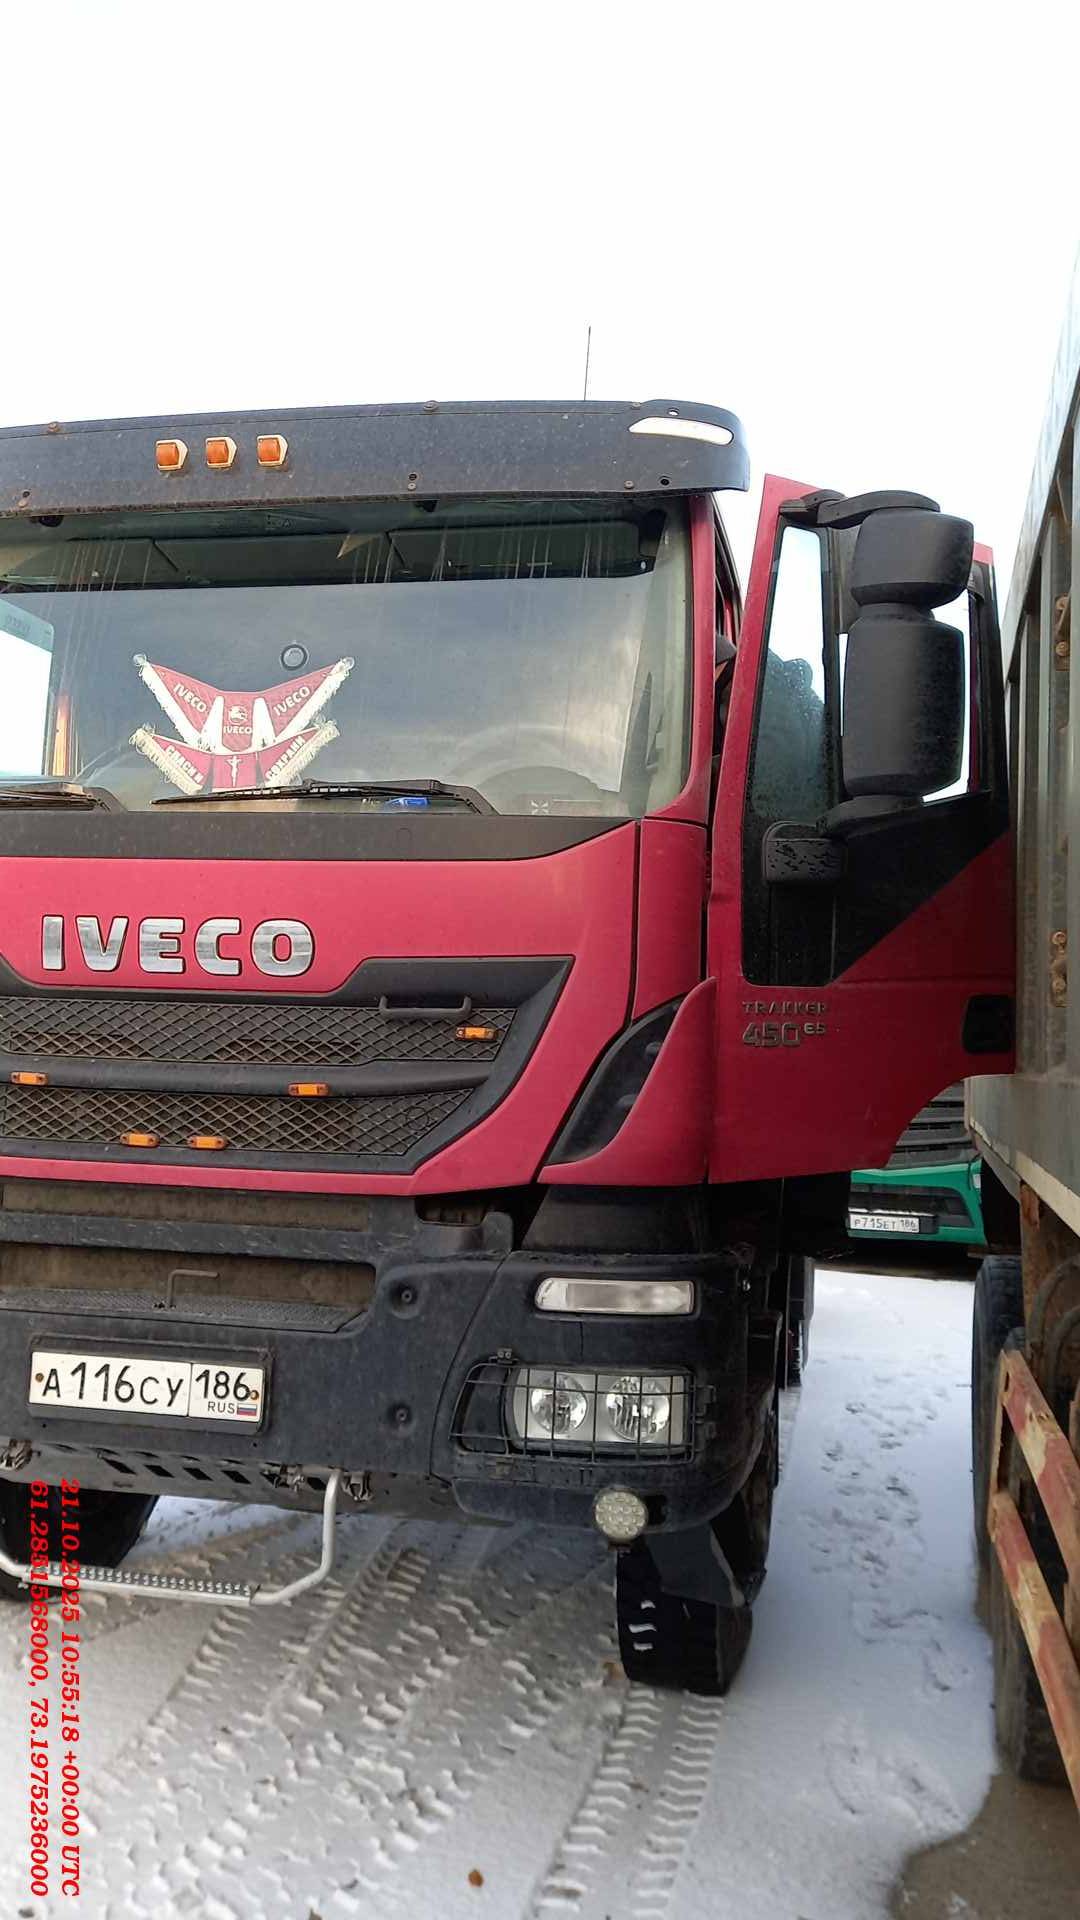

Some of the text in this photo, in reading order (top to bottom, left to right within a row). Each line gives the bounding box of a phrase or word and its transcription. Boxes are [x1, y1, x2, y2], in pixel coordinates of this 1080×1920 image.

[172, 683, 208, 714] IVECO
[272, 686, 311, 717] IVECO
[222, 725, 253, 735] IVECO
[41, 914, 316, 977] IVECO
[741, 1001, 826, 1015] TRAKKER
[742, 1021, 802, 1048] 450
[41, 1361, 251, 1408] А116СУ 186
[207, 1400, 236, 1415] RUS
